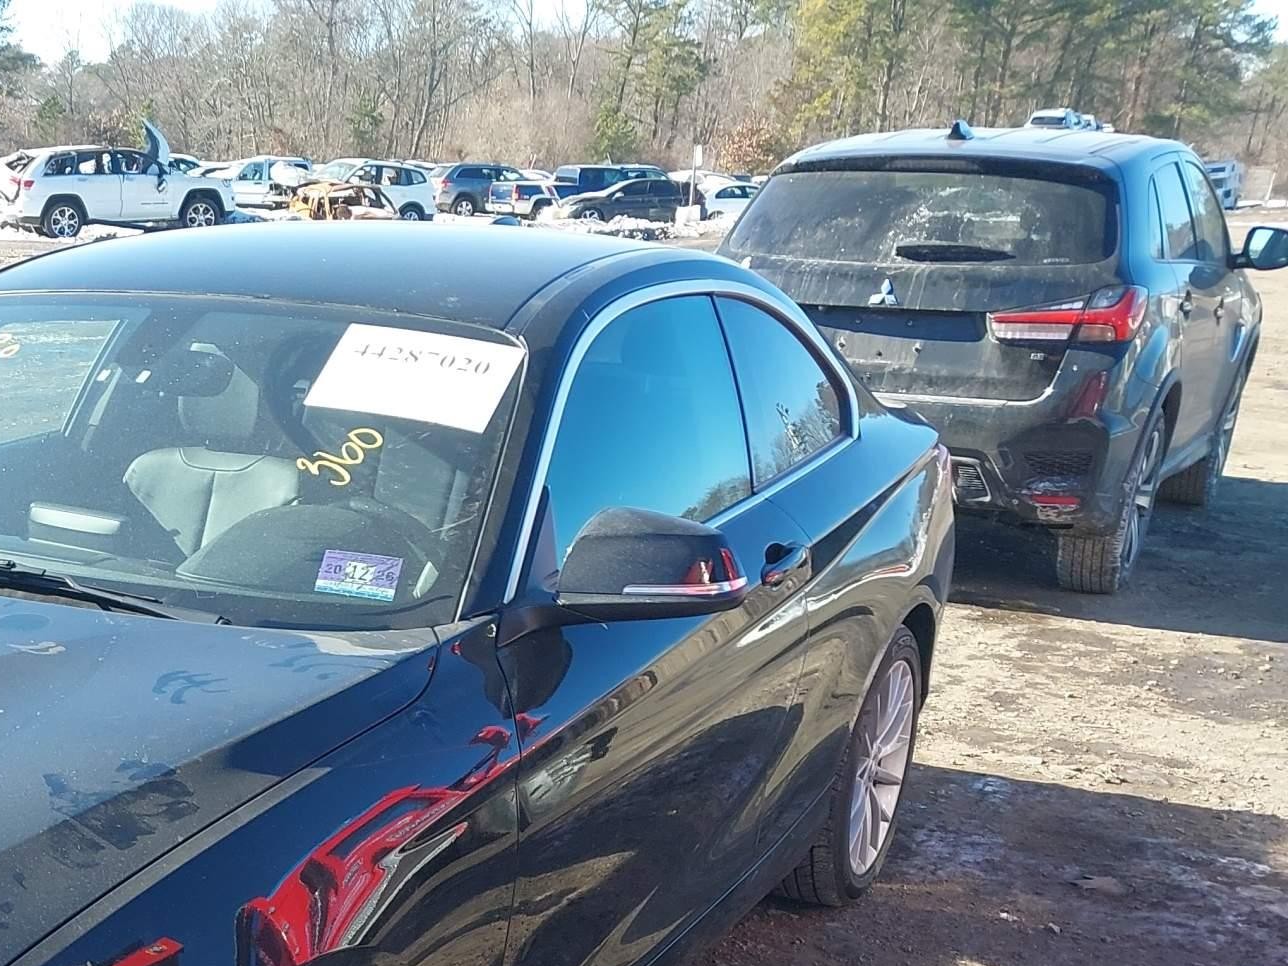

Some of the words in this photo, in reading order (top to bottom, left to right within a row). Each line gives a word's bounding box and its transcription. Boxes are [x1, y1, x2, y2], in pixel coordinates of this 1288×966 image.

[296, 427, 384, 486] 360
[324, 563, 342, 575] 20
[347, 564, 371, 581] 12
